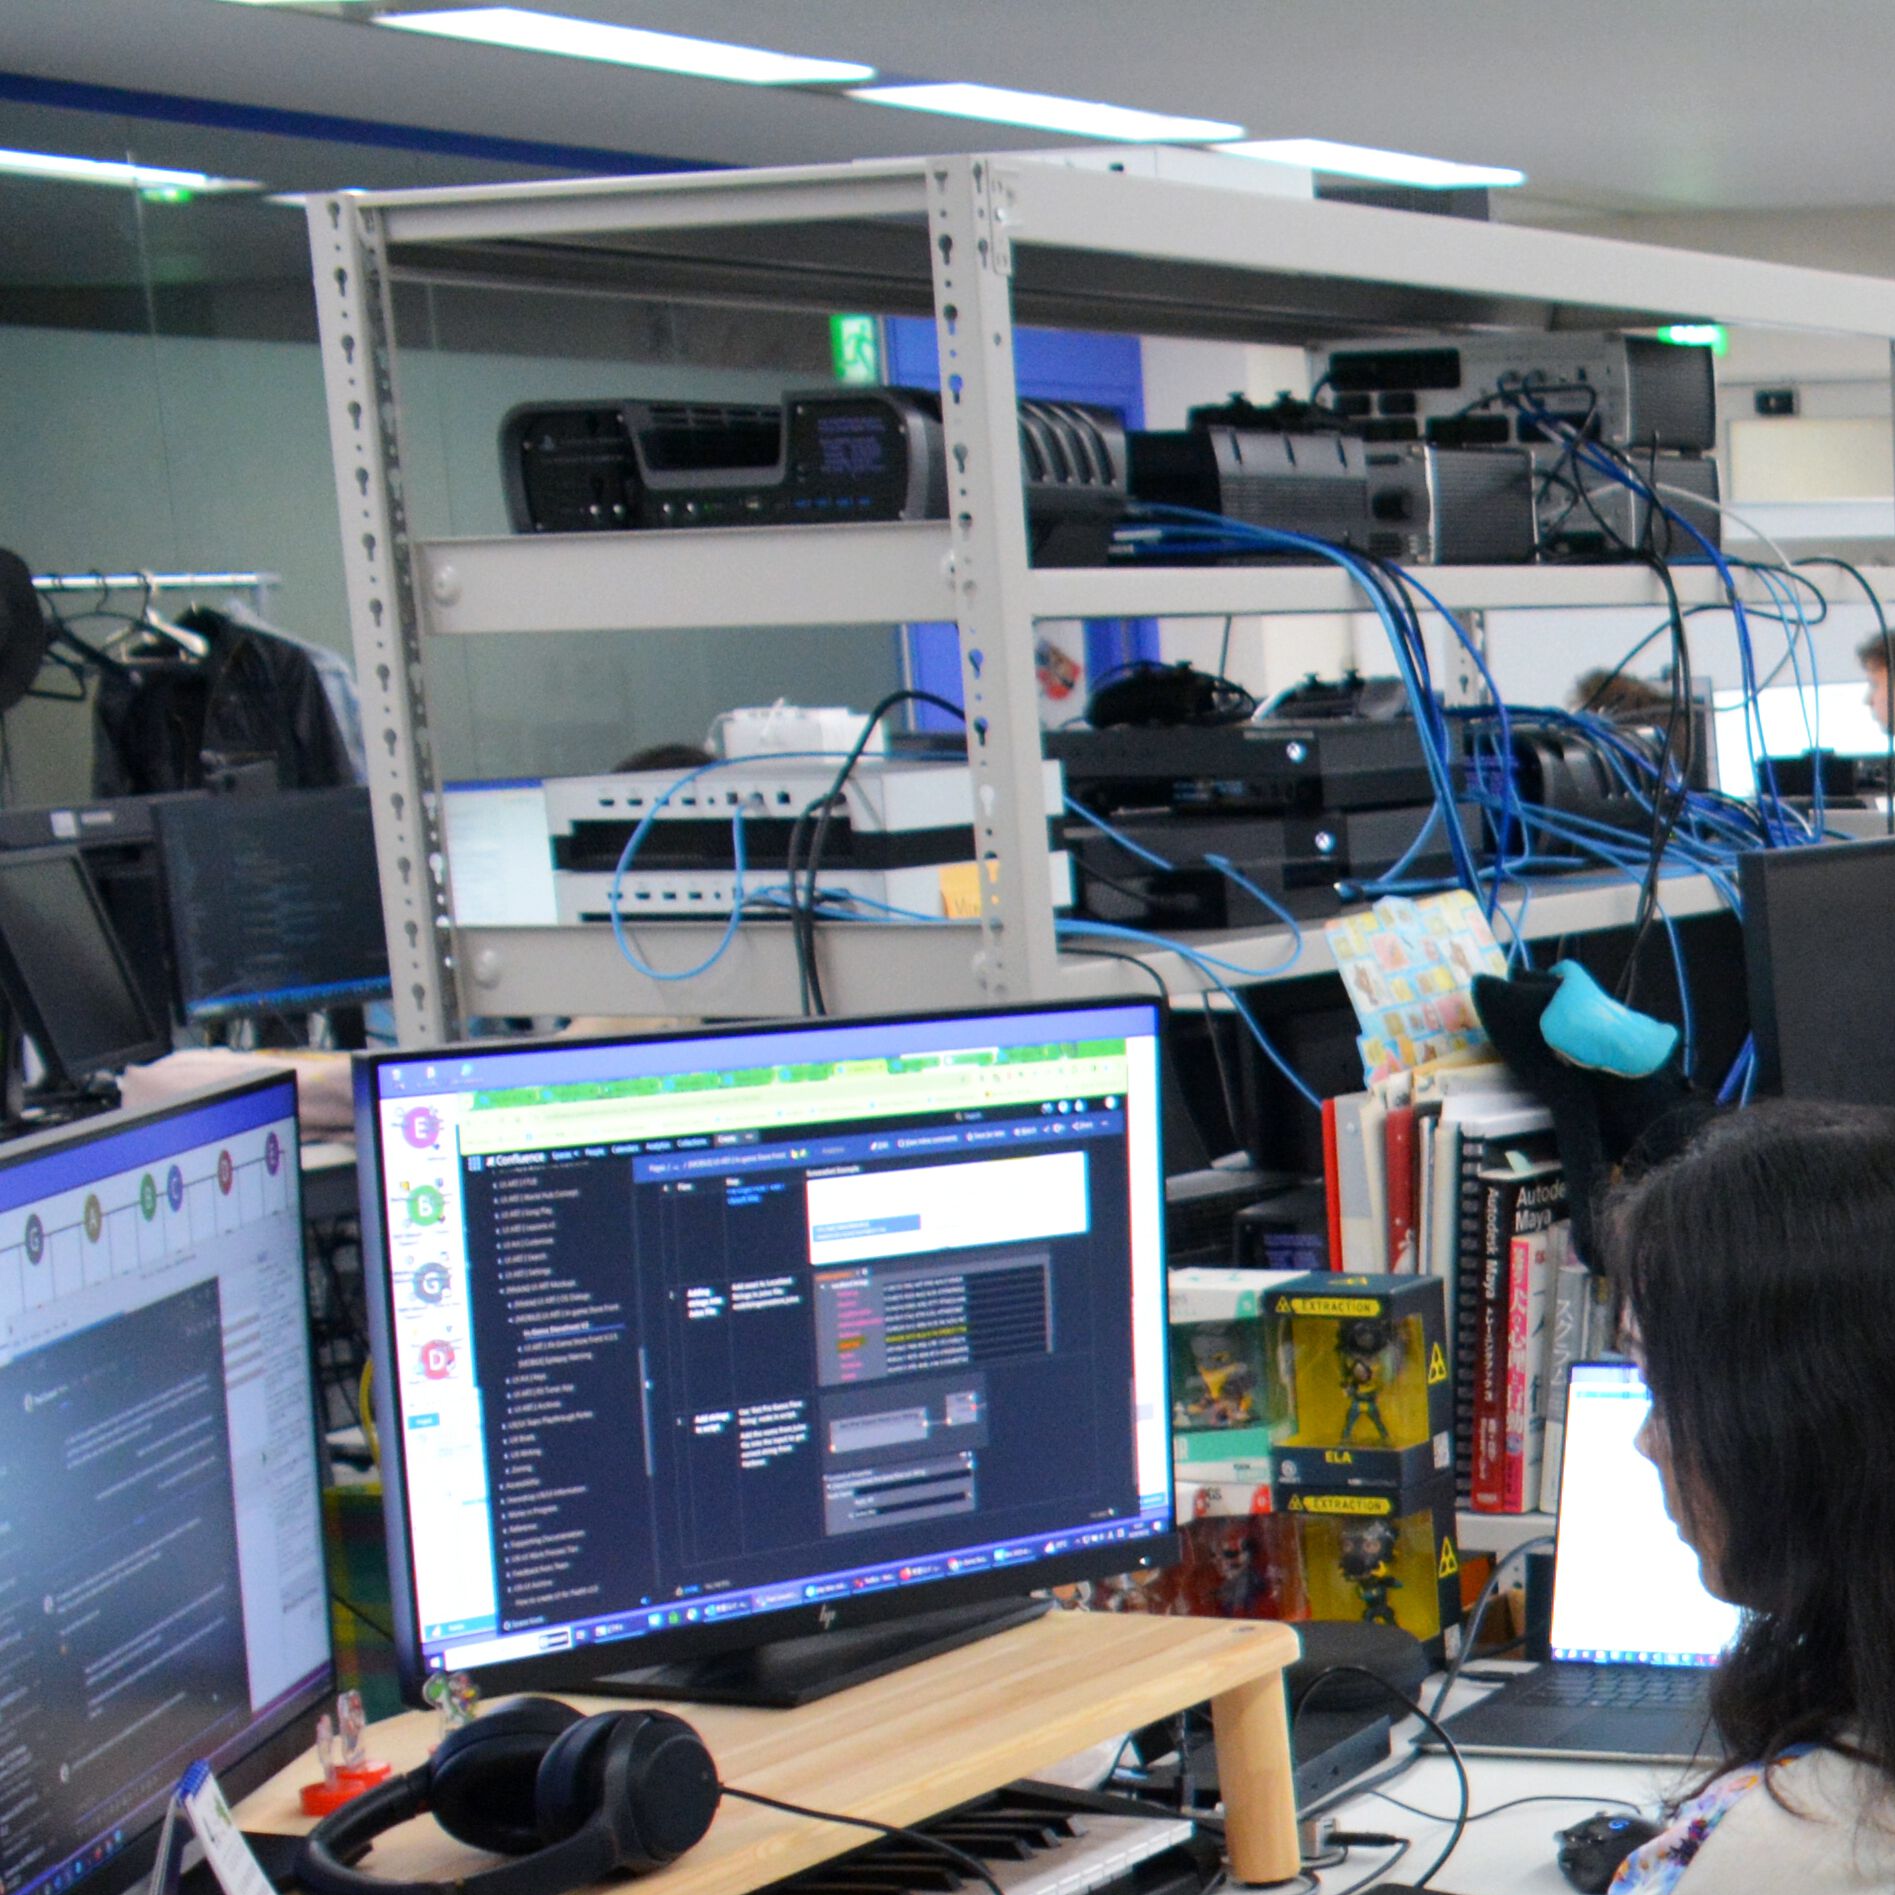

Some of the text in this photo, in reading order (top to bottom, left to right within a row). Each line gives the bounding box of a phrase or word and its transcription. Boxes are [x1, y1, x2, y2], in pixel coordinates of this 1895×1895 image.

[496, 1152, 545, 1167] Confluence
[1515, 1179, 1567, 1209] Autode
[1486, 1186, 1500, 1256] Autodesk
[1515, 1208, 1551, 1233] Maya
[1301, 1300, 1371, 1314] EXTRACTION
[1325, 1451, 1352, 1464] ELA
[1313, 1496, 1383, 1511] EXTRACTION
